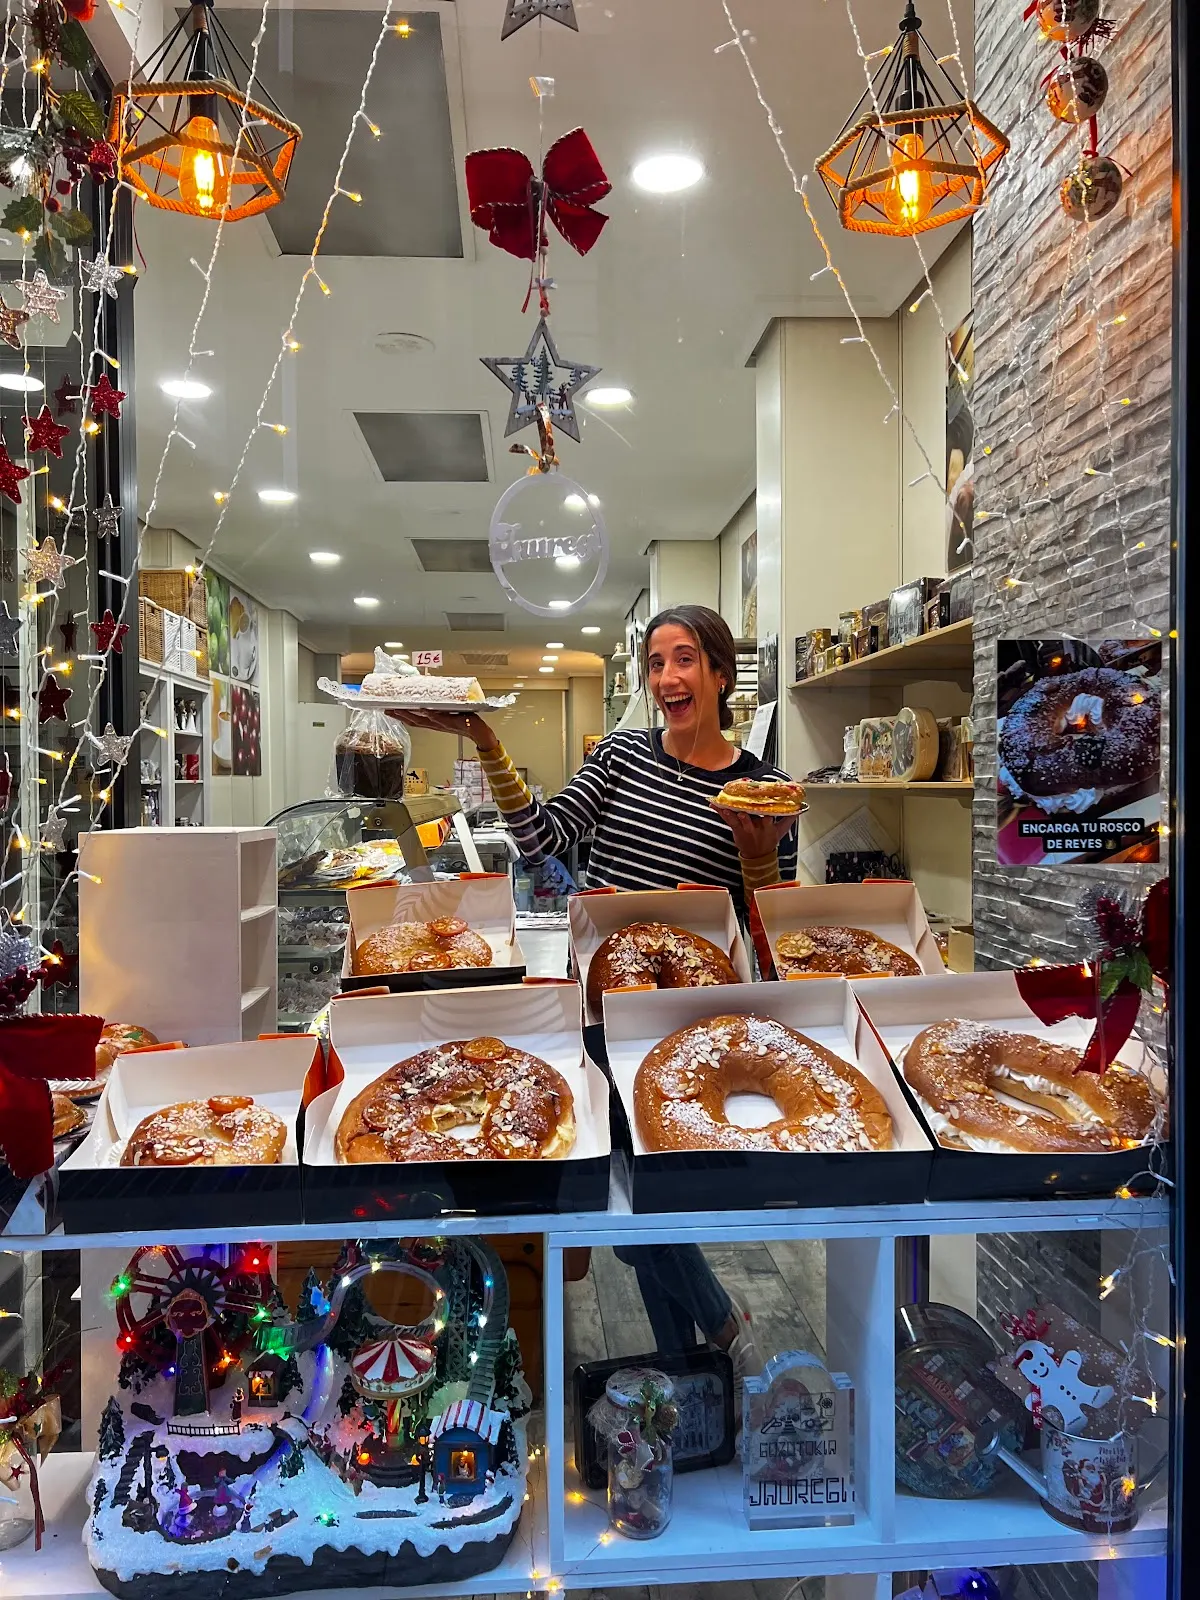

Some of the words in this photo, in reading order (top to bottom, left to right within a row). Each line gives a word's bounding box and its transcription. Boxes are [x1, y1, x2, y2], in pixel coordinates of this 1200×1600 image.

[417, 652, 440, 665] 15€
[1022, 823, 1080, 834] ENCARGA
[1081, 822, 1098, 833] TU
[1099, 821, 1141, 833] ROSCO
[1046, 839, 1063, 849] DE
[1064, 838, 1103, 849] REYES
[759, 1439, 837, 1458] GOZOTOKIA
[749, 1476, 847, 1507] JAUREGI
